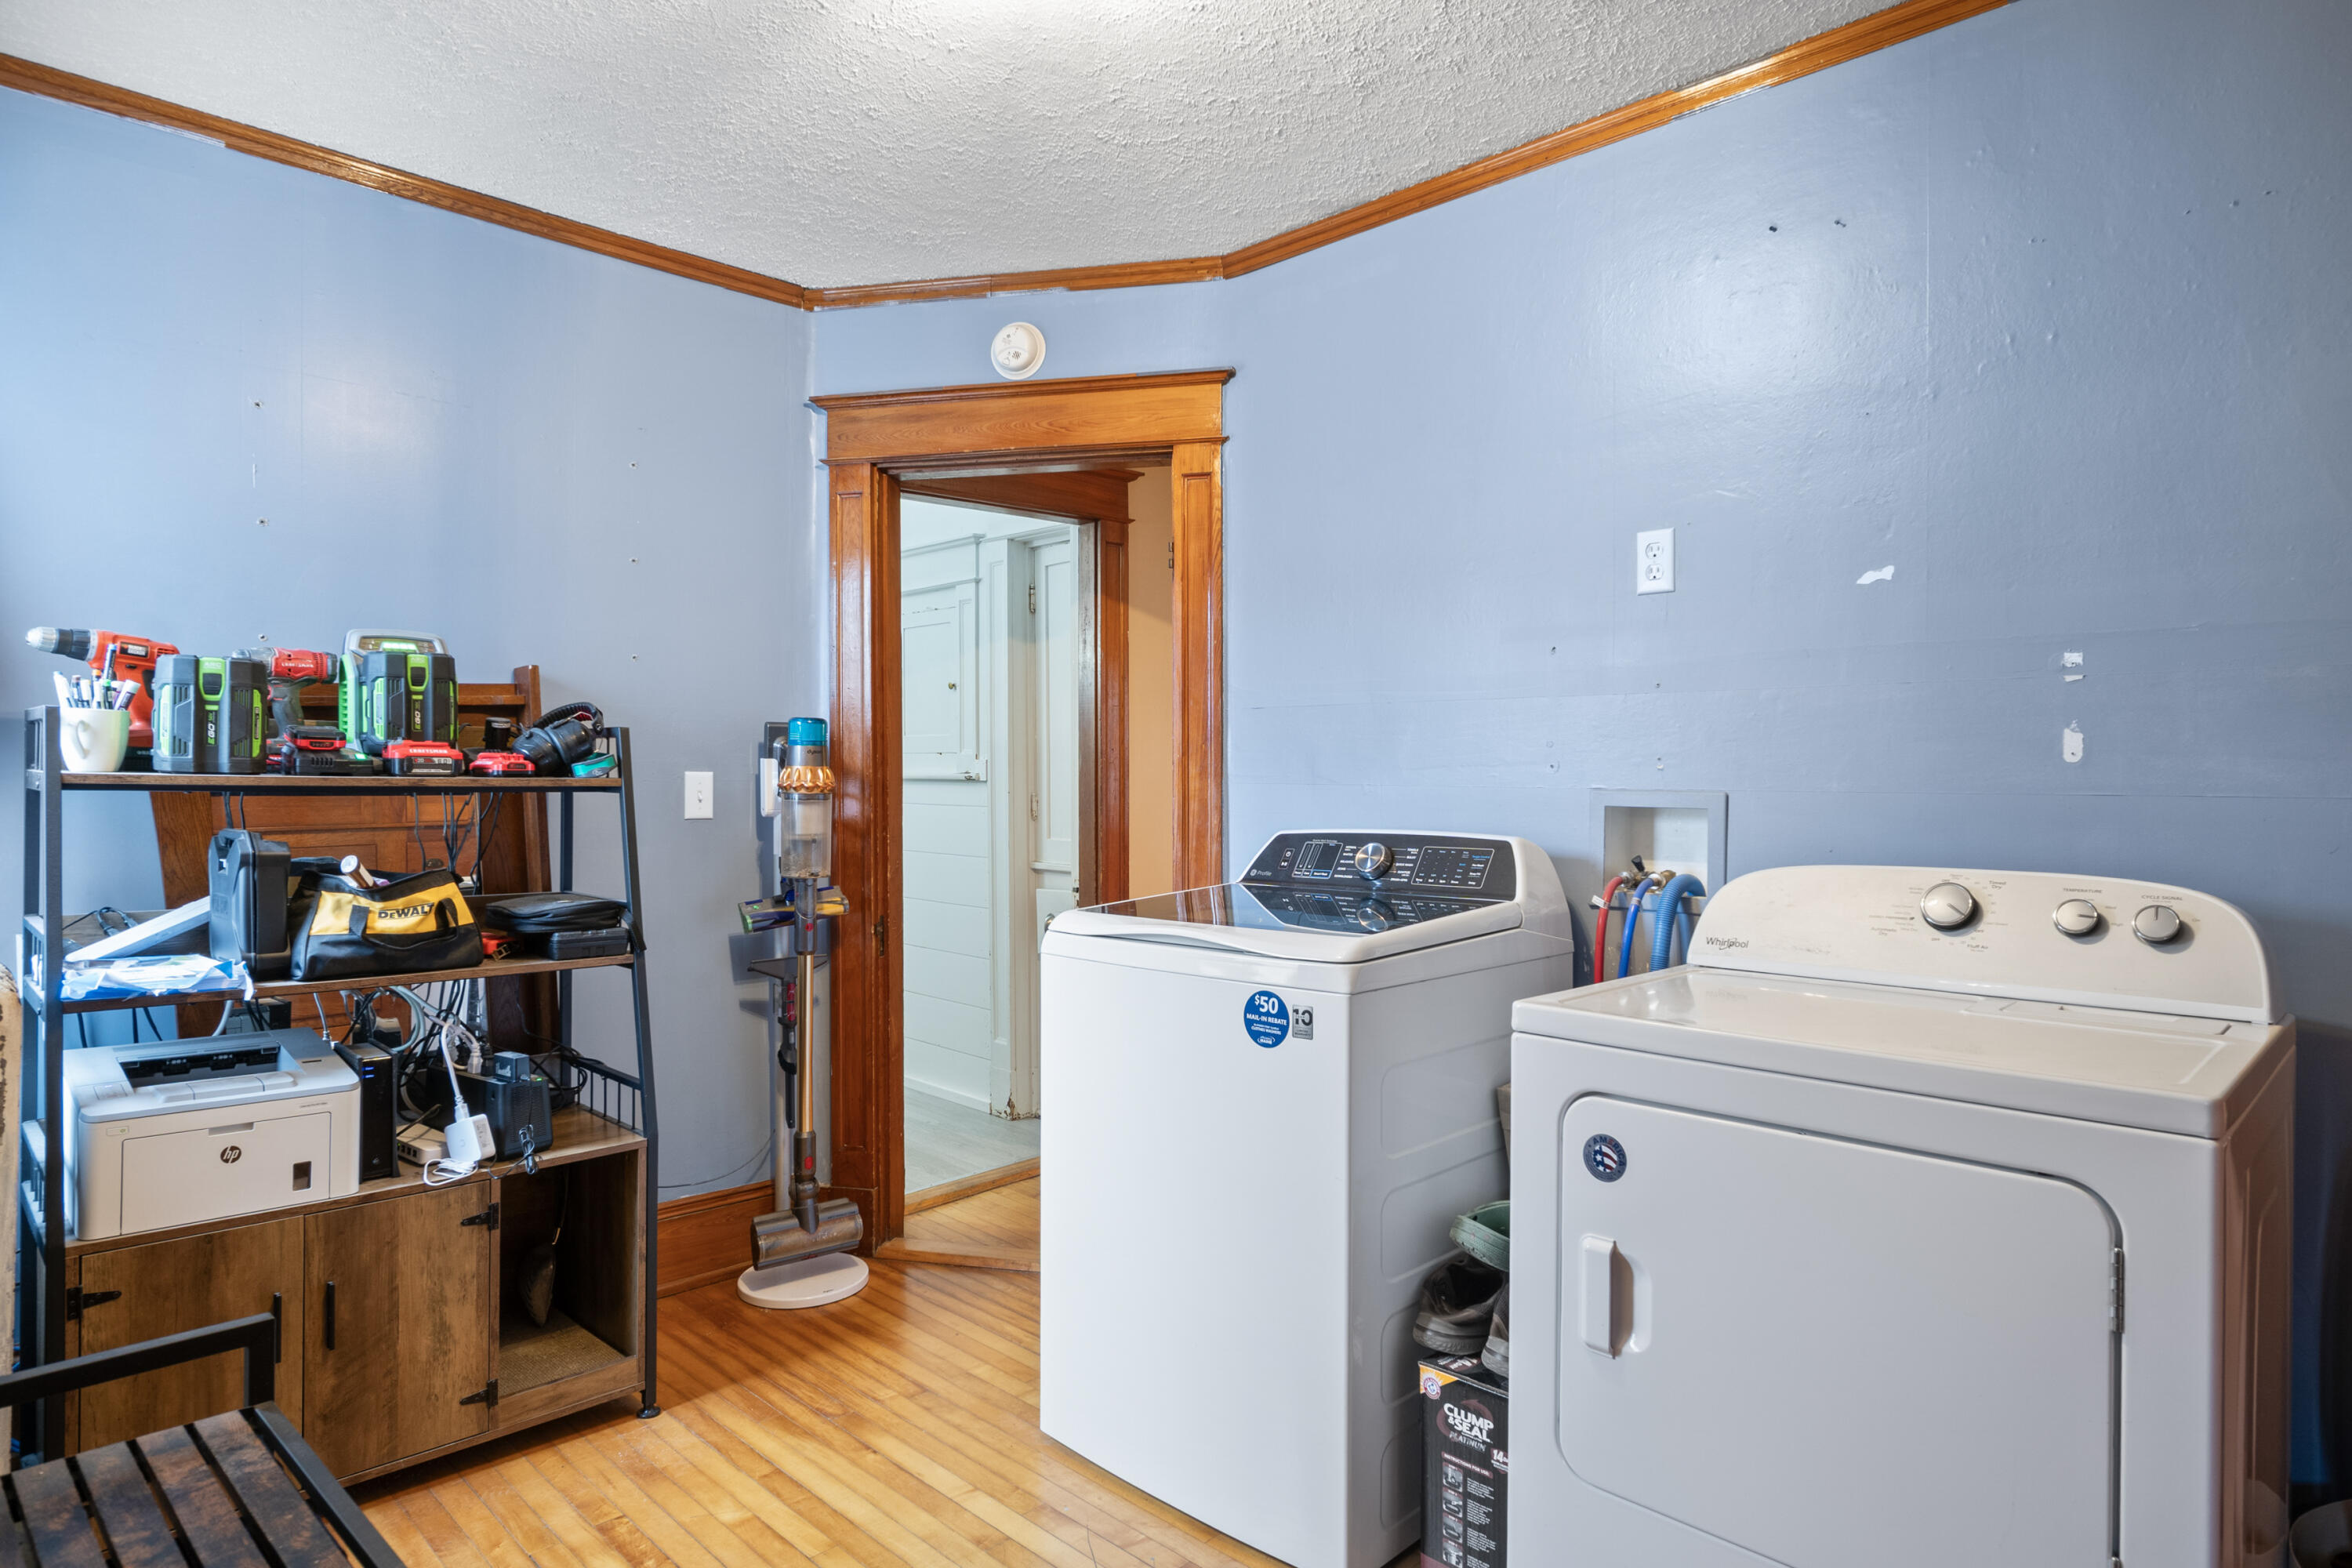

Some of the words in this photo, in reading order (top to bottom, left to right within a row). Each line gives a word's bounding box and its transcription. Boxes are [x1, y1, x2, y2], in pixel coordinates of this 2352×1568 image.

[1705, 936, 1750, 950] Whirlpool
[1254, 993, 1279, 1014] $50
[1246, 1013, 1268, 1022] MAIL-IN
[1268, 1016, 1287, 1025] REBATE
[222, 1145, 240, 1163] hp
[1593, 1136, 1625, 1167] AMERICA
[1443, 1403, 1494, 1431] CLUMP
[1449, 1431, 1486, 1452] PLATINUM
[1443, 1453, 1472, 1468] INSTRUCTIONS
[1493, 1449, 1504, 1463] 14
